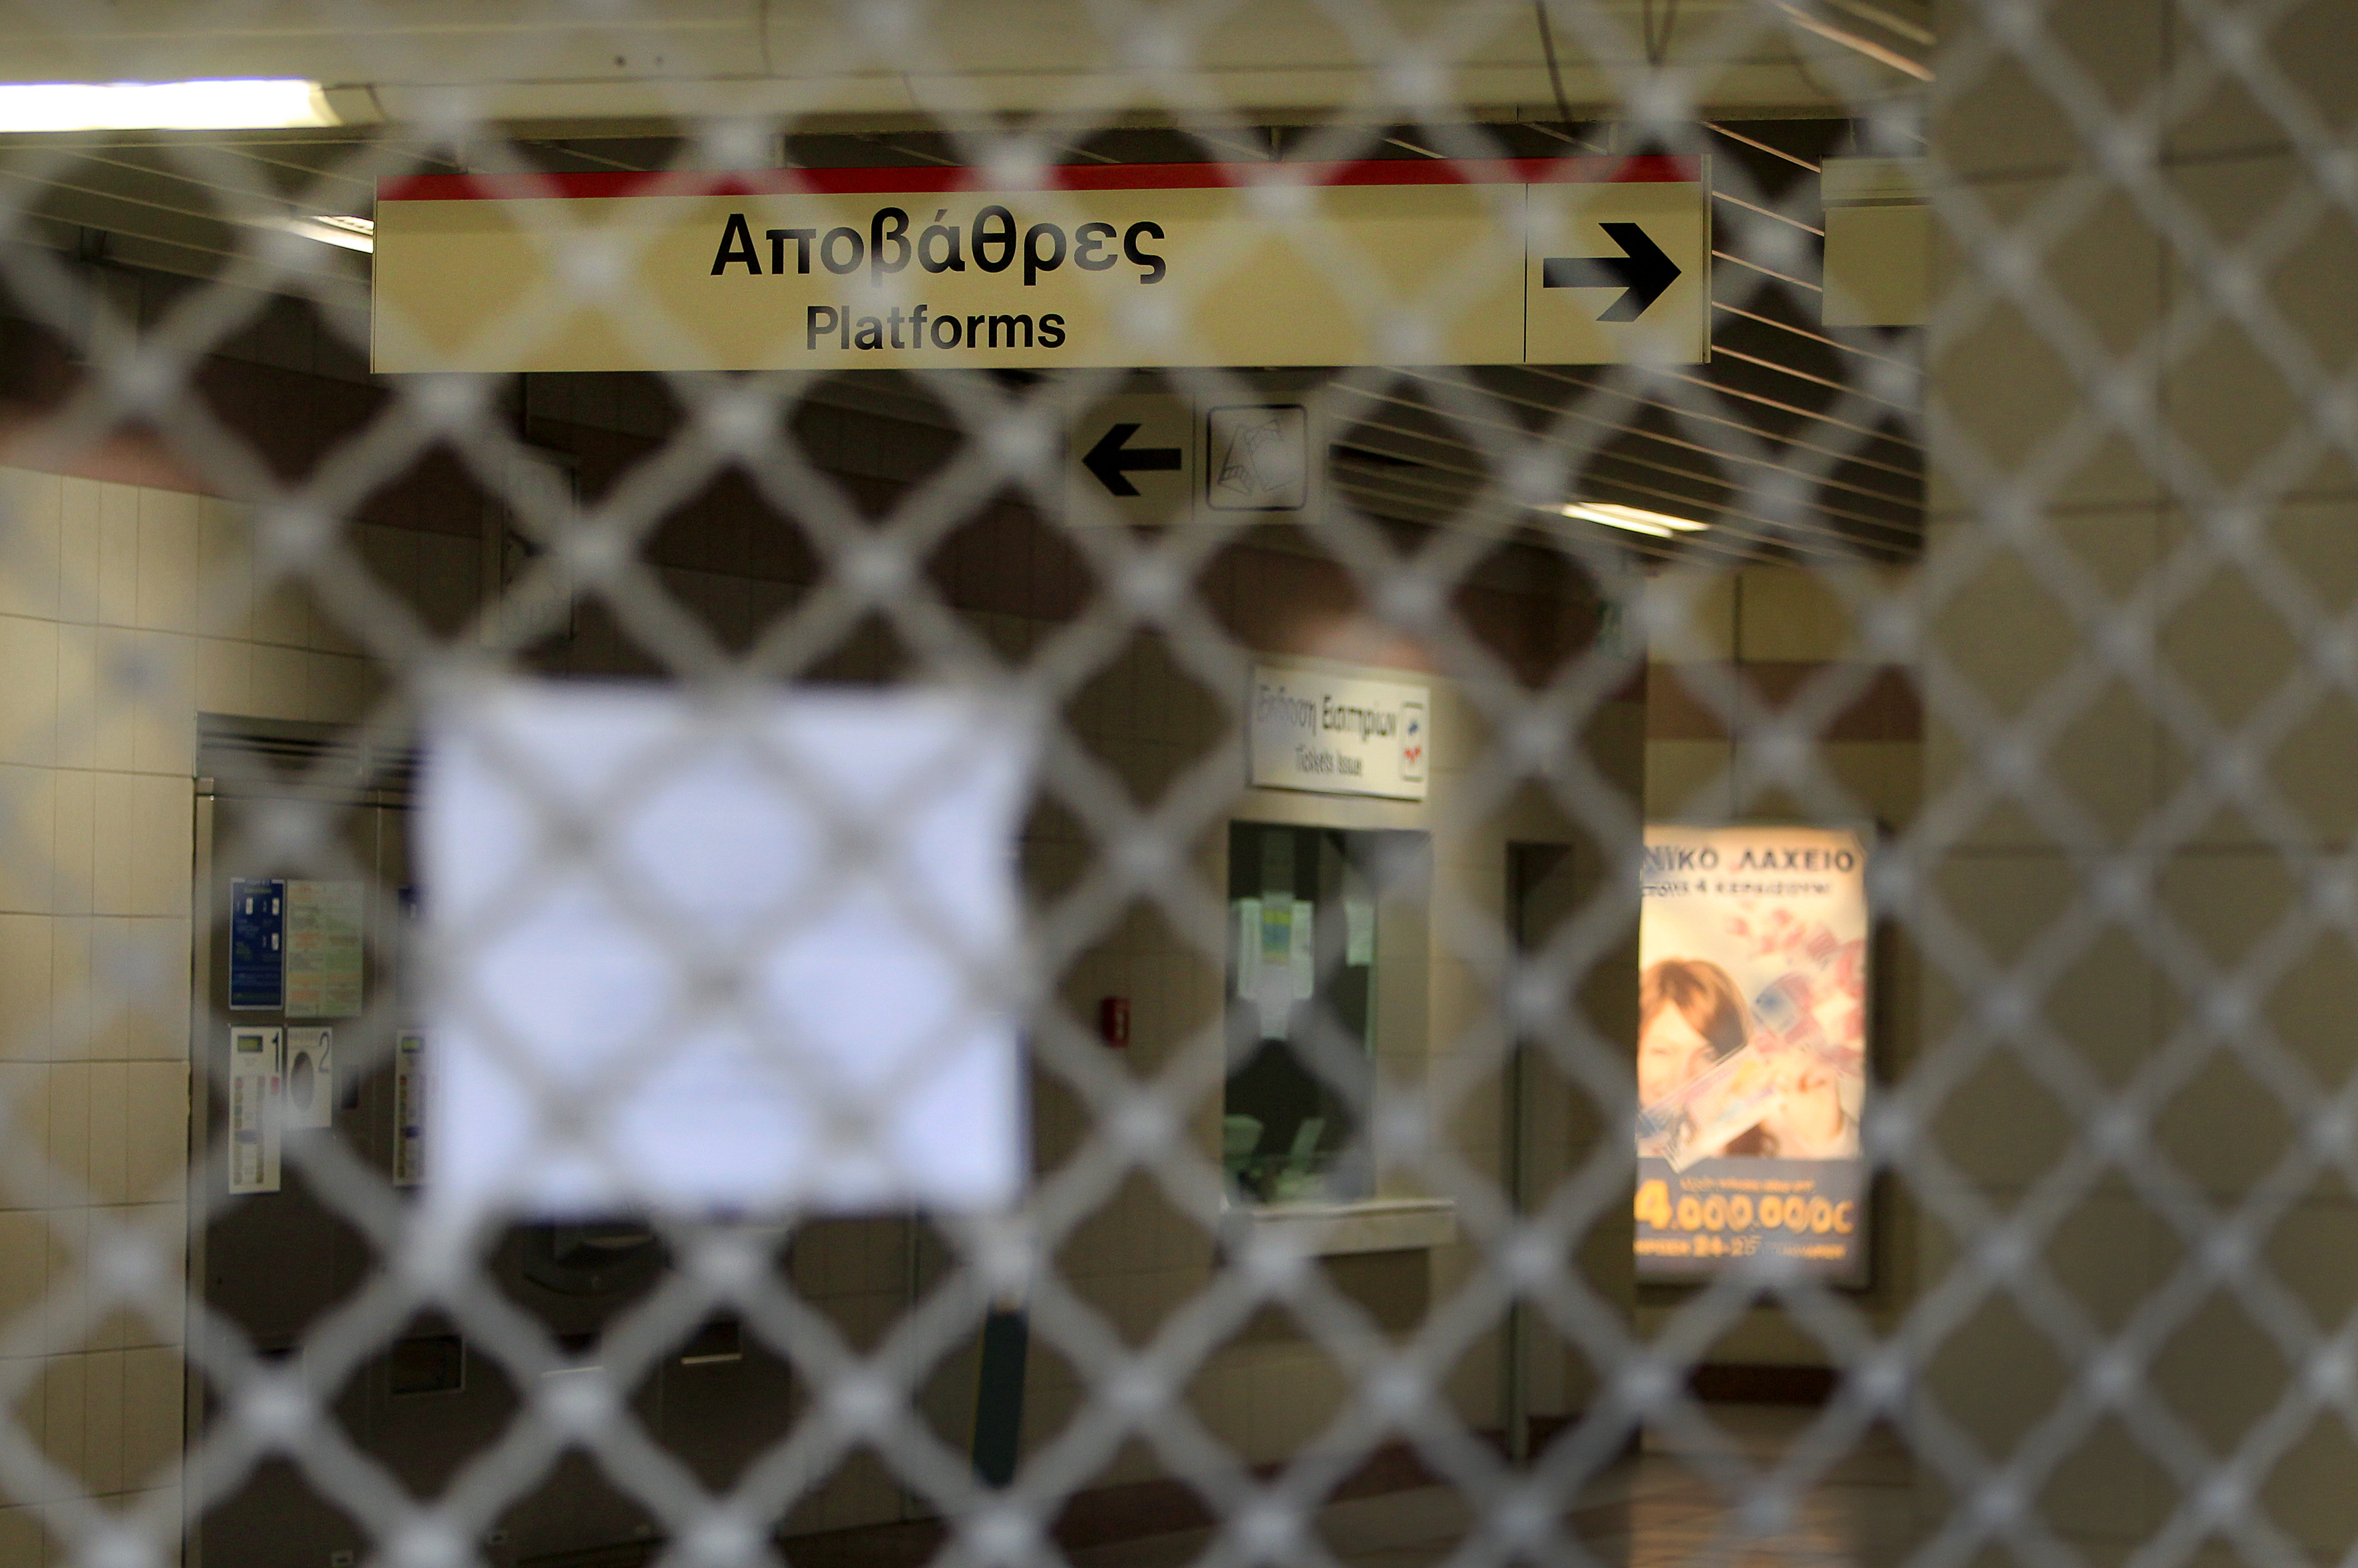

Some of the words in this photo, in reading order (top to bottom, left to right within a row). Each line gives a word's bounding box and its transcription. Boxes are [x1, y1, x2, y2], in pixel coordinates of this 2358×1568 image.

[709, 204, 1167, 286] Αποβάθρες
[806, 303, 1066, 350] Platforms
[1738, 847, 1855, 873] ΛΑΧΕΙΟ
